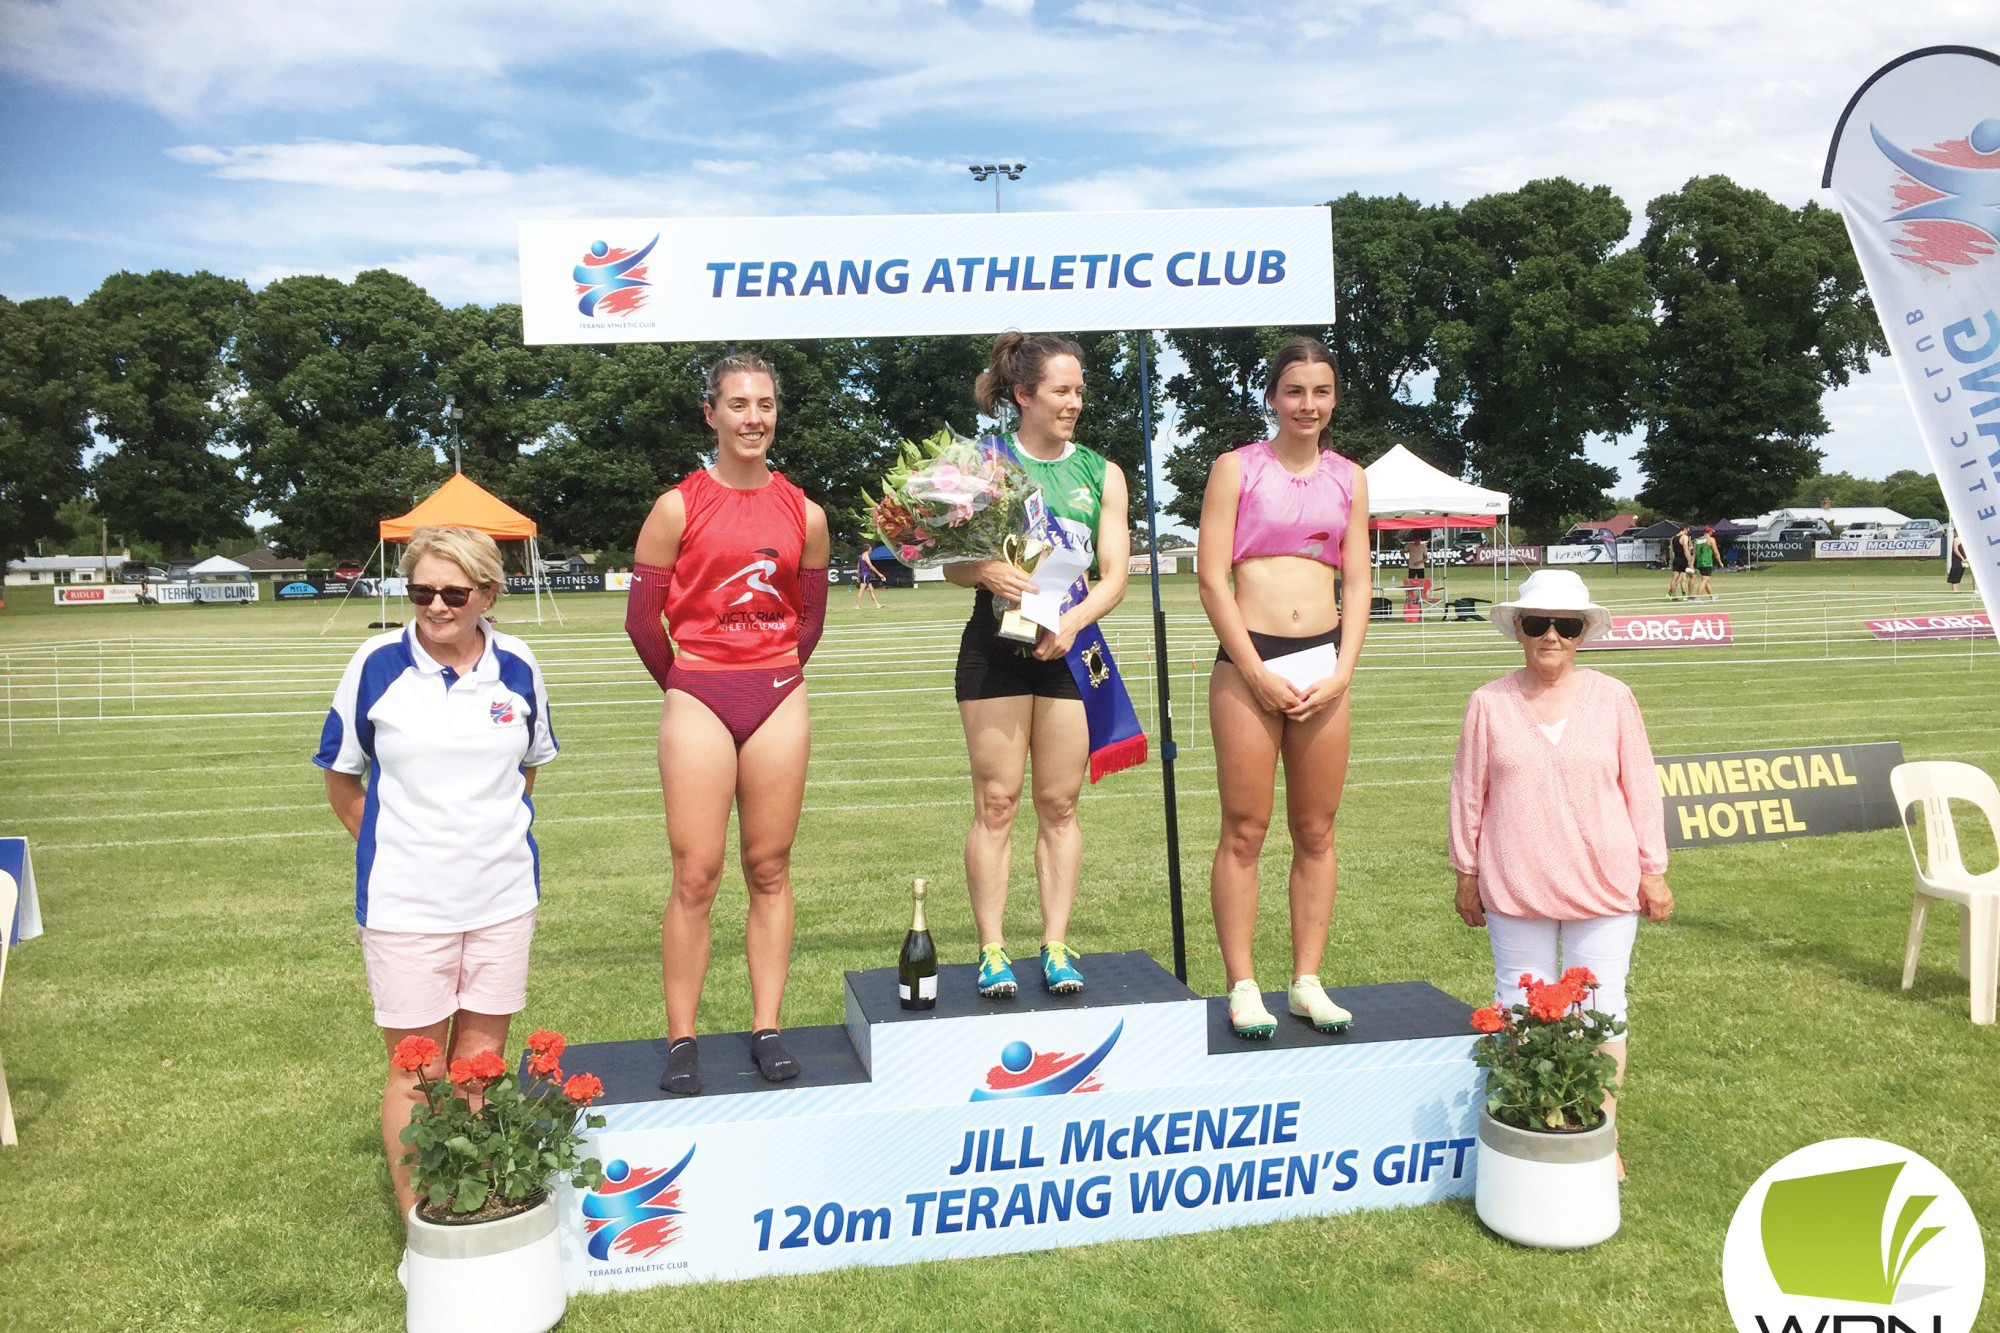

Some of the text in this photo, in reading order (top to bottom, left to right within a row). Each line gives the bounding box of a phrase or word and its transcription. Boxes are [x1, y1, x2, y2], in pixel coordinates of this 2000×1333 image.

[706, 250, 1286, 298] TERANG ATHLETIC CLUB
[1821, 540, 1935, 551] SEAN MOLONEY
[556, 575, 600, 585] FITNESS
[70, 591, 101, 599] RIDLEY
[161, 585, 255, 600] TERANG VET CLINIC
[716, 611, 785, 624] VICTORIAN
[1873, 615, 1993, 632] VAL.ORG.
[716, 622, 787, 632] ATHLETIC LEAGUE
[1600, 619, 1725, 641] L.ORG.AU
[1655, 753, 1857, 797] MMERCIAL
[1677, 798, 1807, 839] HOTEL
[950, 1101, 1300, 1176] JILL McKENZIE
[753, 1201, 892, 1251] 120m
[905, 1175, 1112, 1236] TERANG
[1373, 1138, 1476, 1187] GIFT
[588, 1261, 689, 1277] TERANG ATHLETIC CLUB
